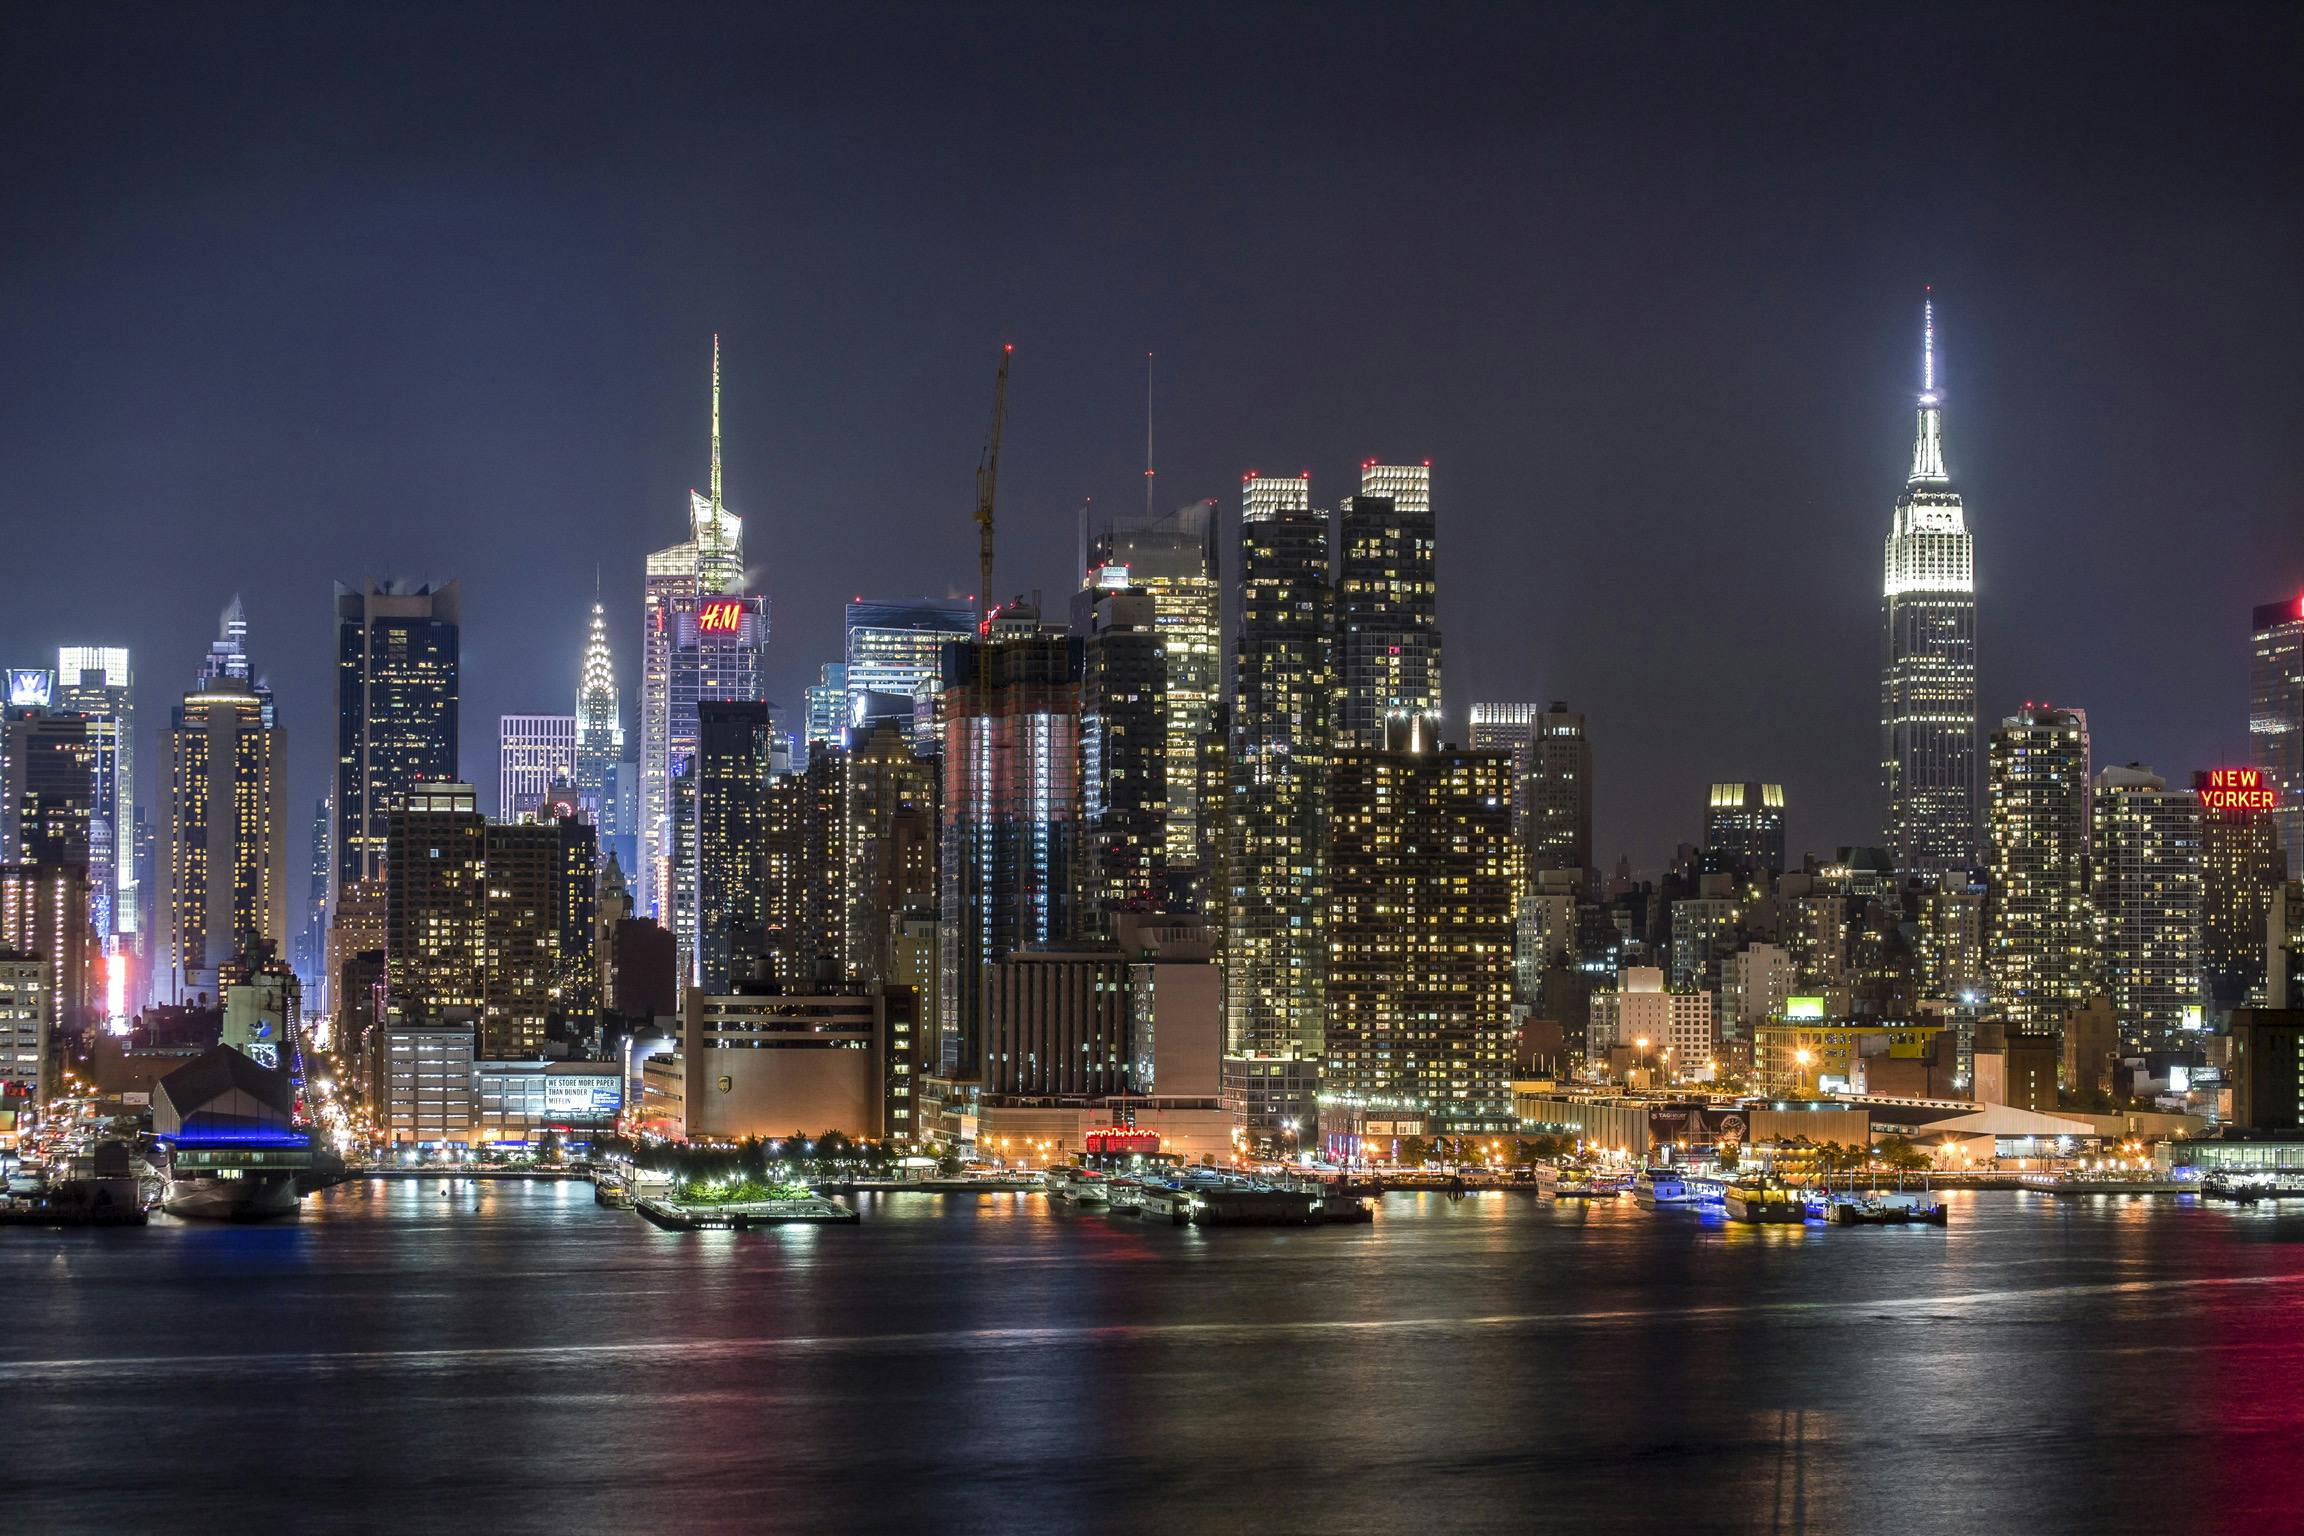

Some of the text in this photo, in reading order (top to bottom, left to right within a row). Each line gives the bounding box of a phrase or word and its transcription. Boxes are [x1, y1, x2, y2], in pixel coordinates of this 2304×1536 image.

[700, 605, 740, 630] H&M
[19, 674, 40, 689] W
[2212, 771, 2256, 786] NEW
[2201, 791, 2274, 807] YORKER
